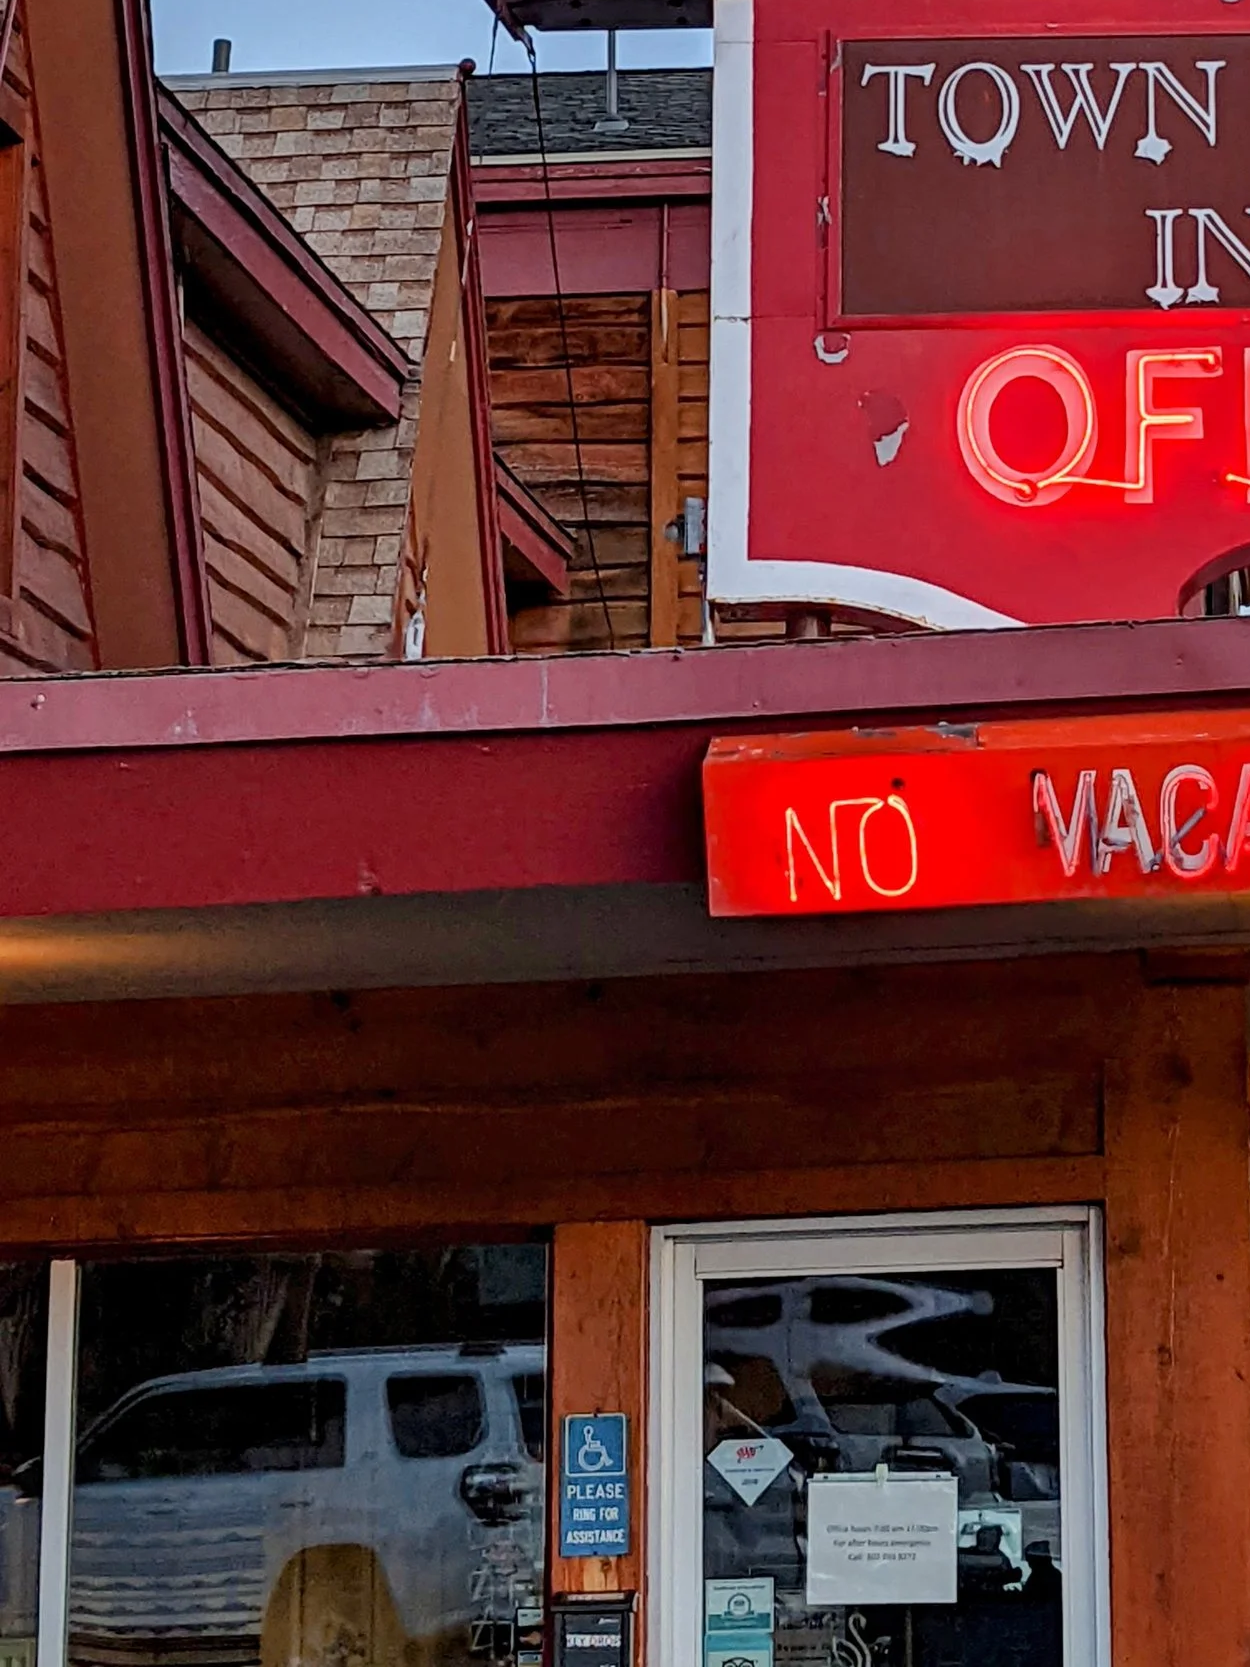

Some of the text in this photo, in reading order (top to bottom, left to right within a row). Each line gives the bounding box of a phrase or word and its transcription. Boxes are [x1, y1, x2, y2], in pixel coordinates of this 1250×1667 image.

[861, 58, 1227, 166] TOWN
[783, 793, 919, 902] NO
[566, 1483, 625, 1500] PLEASE
[573, 1506, 620, 1521] RING FOR
[565, 1528, 626, 1544] ASSISTANCE
